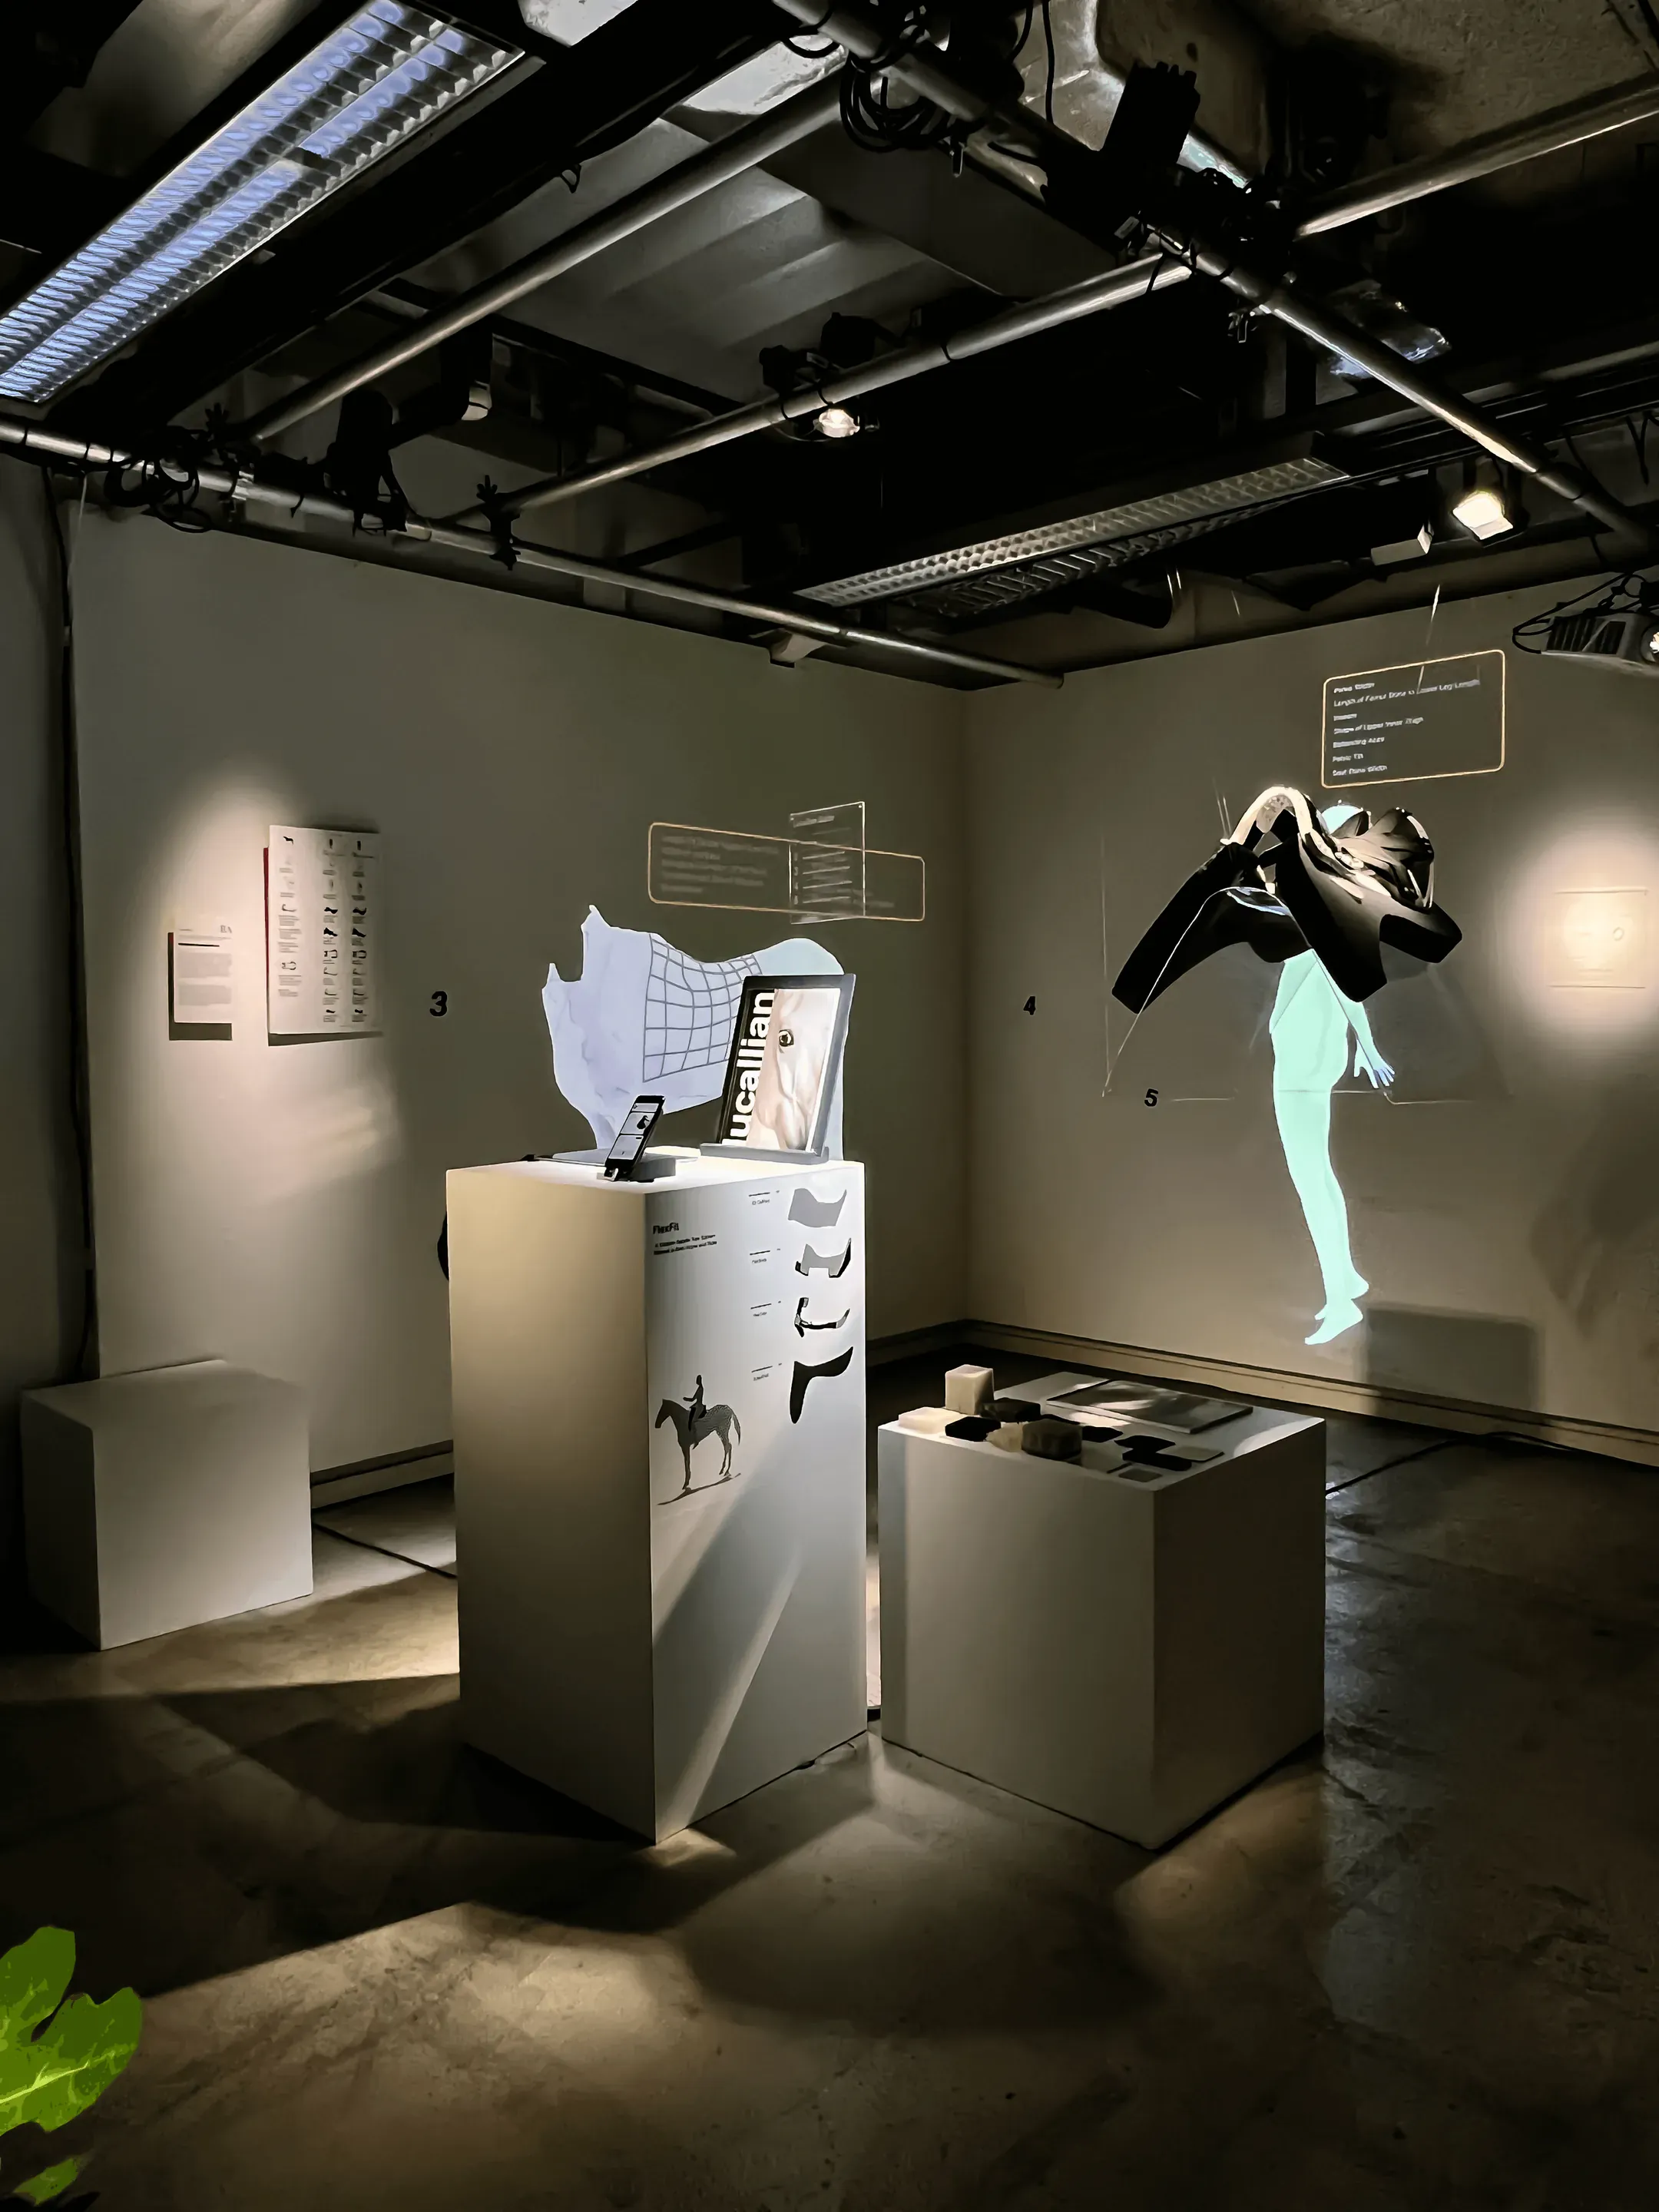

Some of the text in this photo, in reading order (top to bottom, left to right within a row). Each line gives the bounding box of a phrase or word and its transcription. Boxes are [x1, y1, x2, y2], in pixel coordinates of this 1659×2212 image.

[429, 991, 447, 1016] 3
[1023, 995, 1036, 1015] 4
[1144, 1088, 1159, 1107] 5
